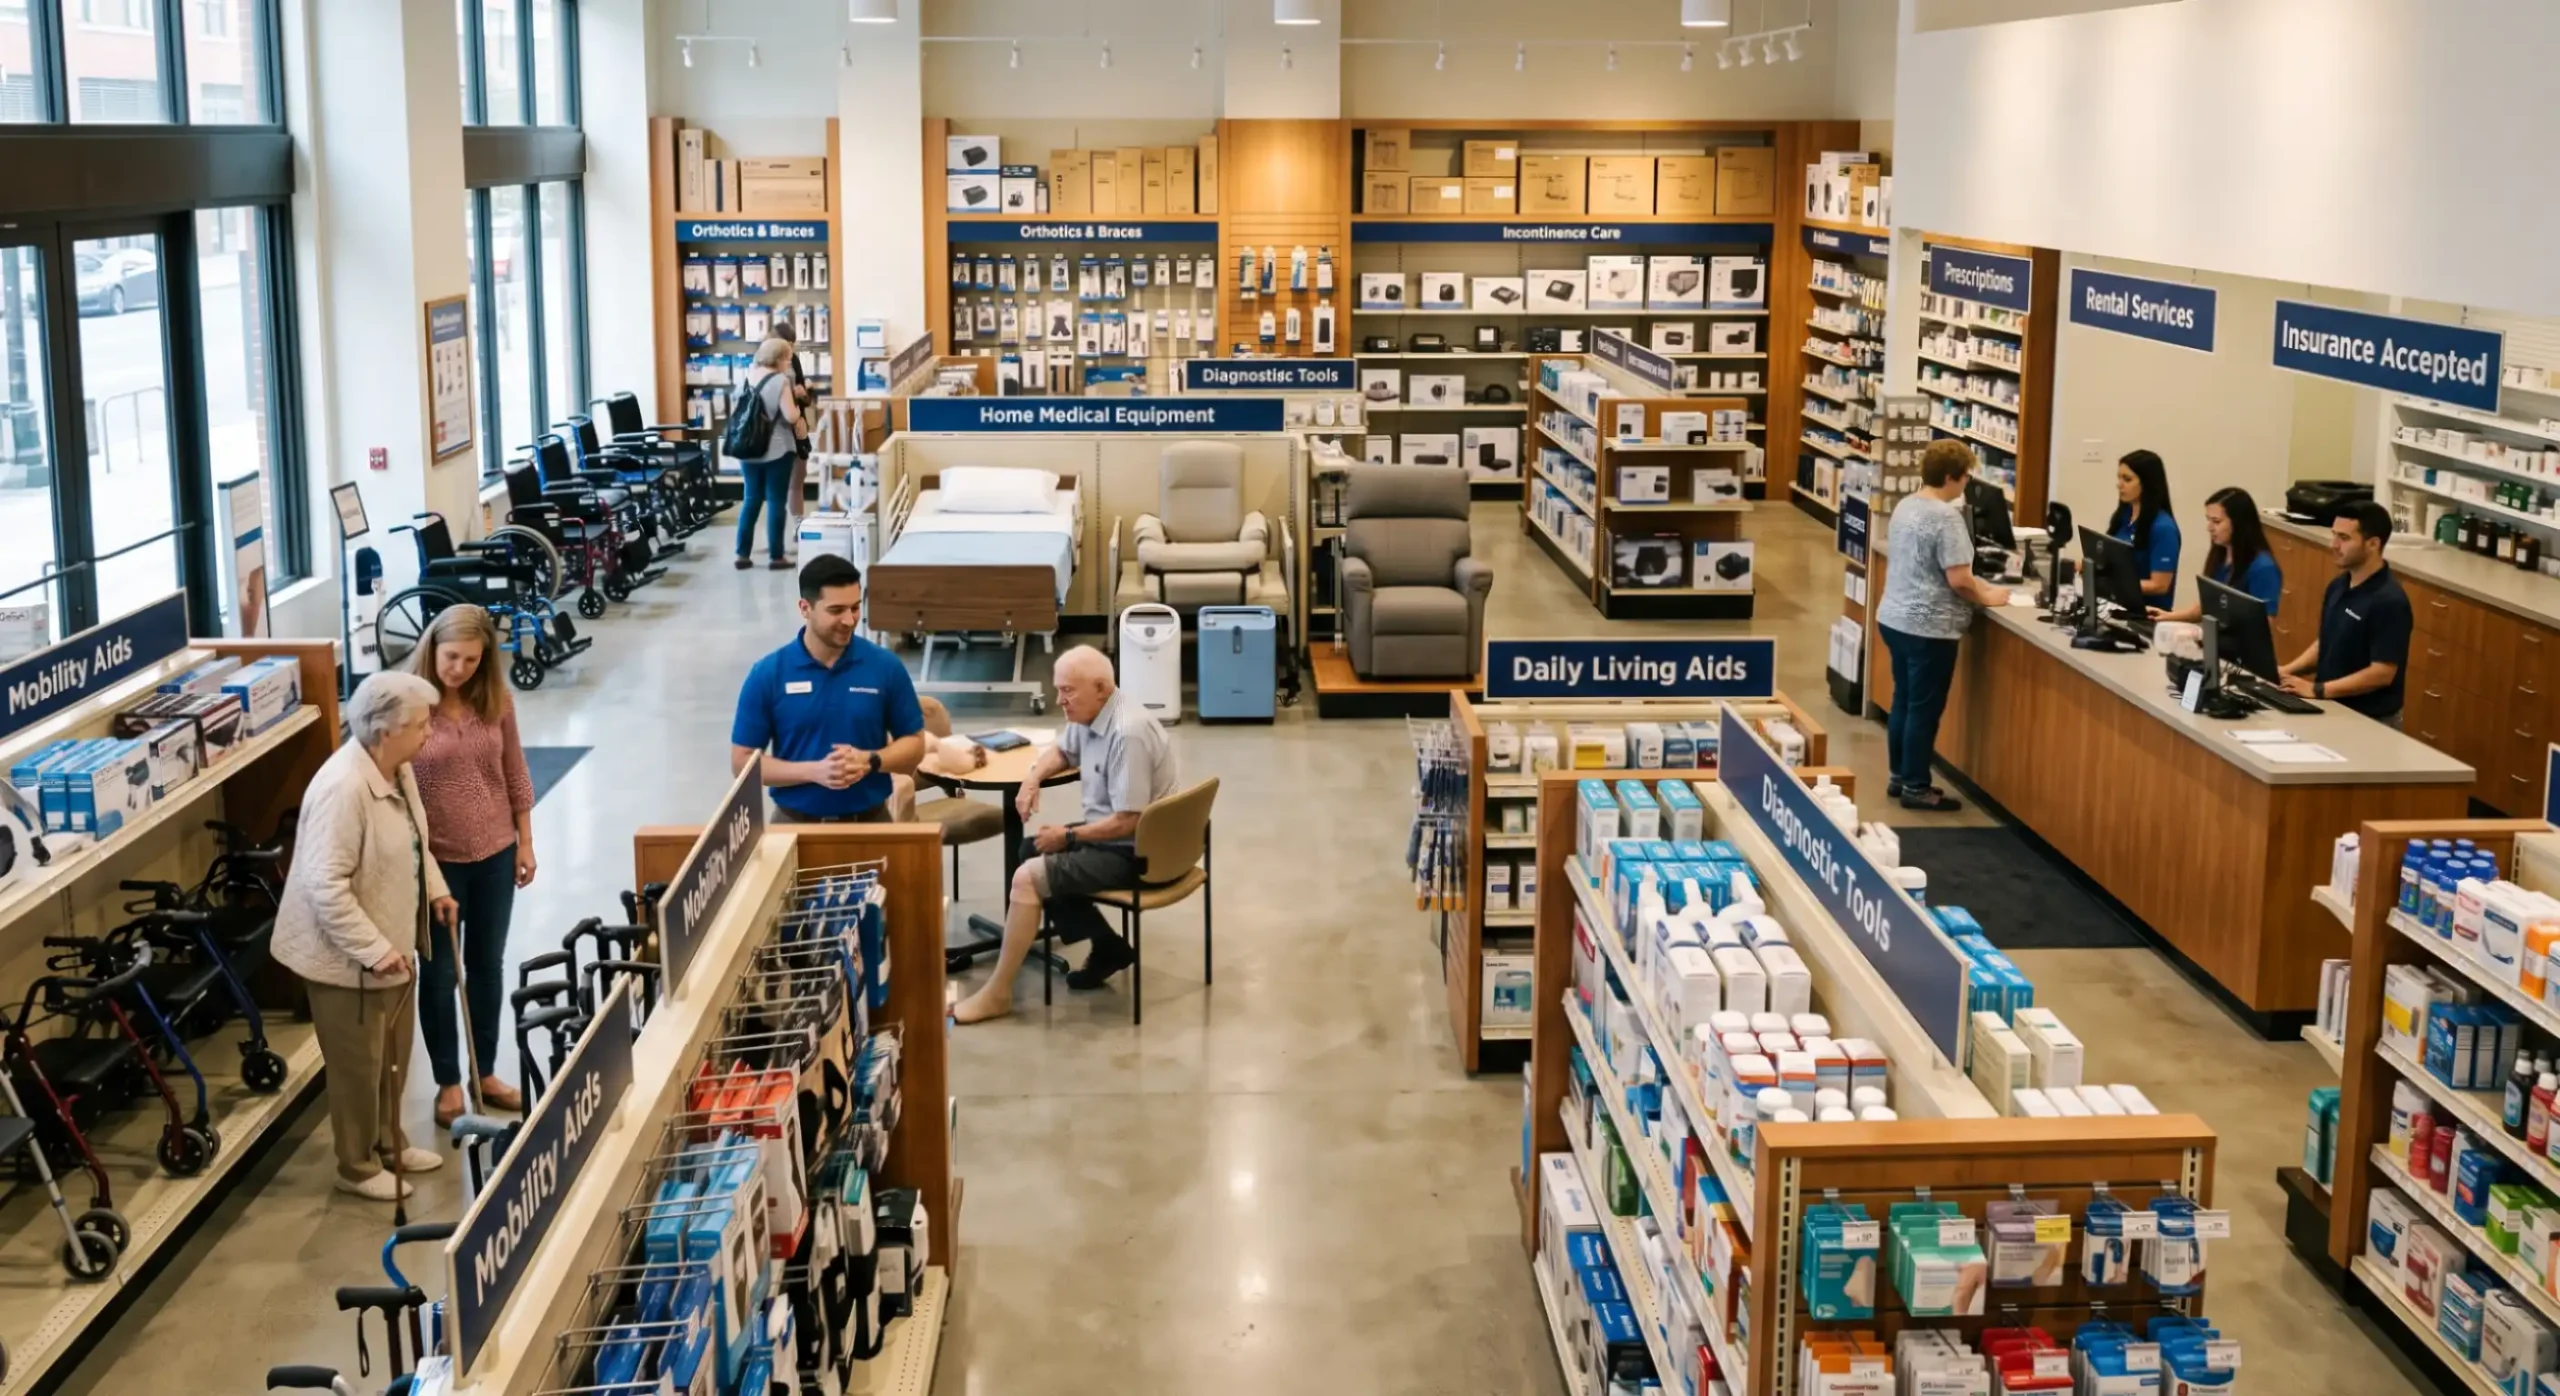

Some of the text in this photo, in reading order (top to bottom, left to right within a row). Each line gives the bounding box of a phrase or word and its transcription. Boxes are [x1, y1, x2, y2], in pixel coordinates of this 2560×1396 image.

[692, 224, 815, 238] Orthotics & Braces
[1020, 224, 1143, 239] Orthotics & Braces
[1502, 225, 1621, 239] Incontinence Care
[1944, 261, 2014, 294] Prescriptions
[2086, 286, 2194, 330] Rental Services
[2281, 320, 2488, 386] Insurance Accepted
[1297, 367, 1339, 383] Tools
[980, 406, 1216, 427] Home Medical Equipment
[8, 635, 133, 716] Mobility Aids
[1513, 655, 1747, 687] Daily Living Aids
[683, 804, 750, 937] Mobility Aids
[1762, 773, 1891, 952] Diagnostic Tools
[474, 1070, 602, 1308] Mobility Aids
